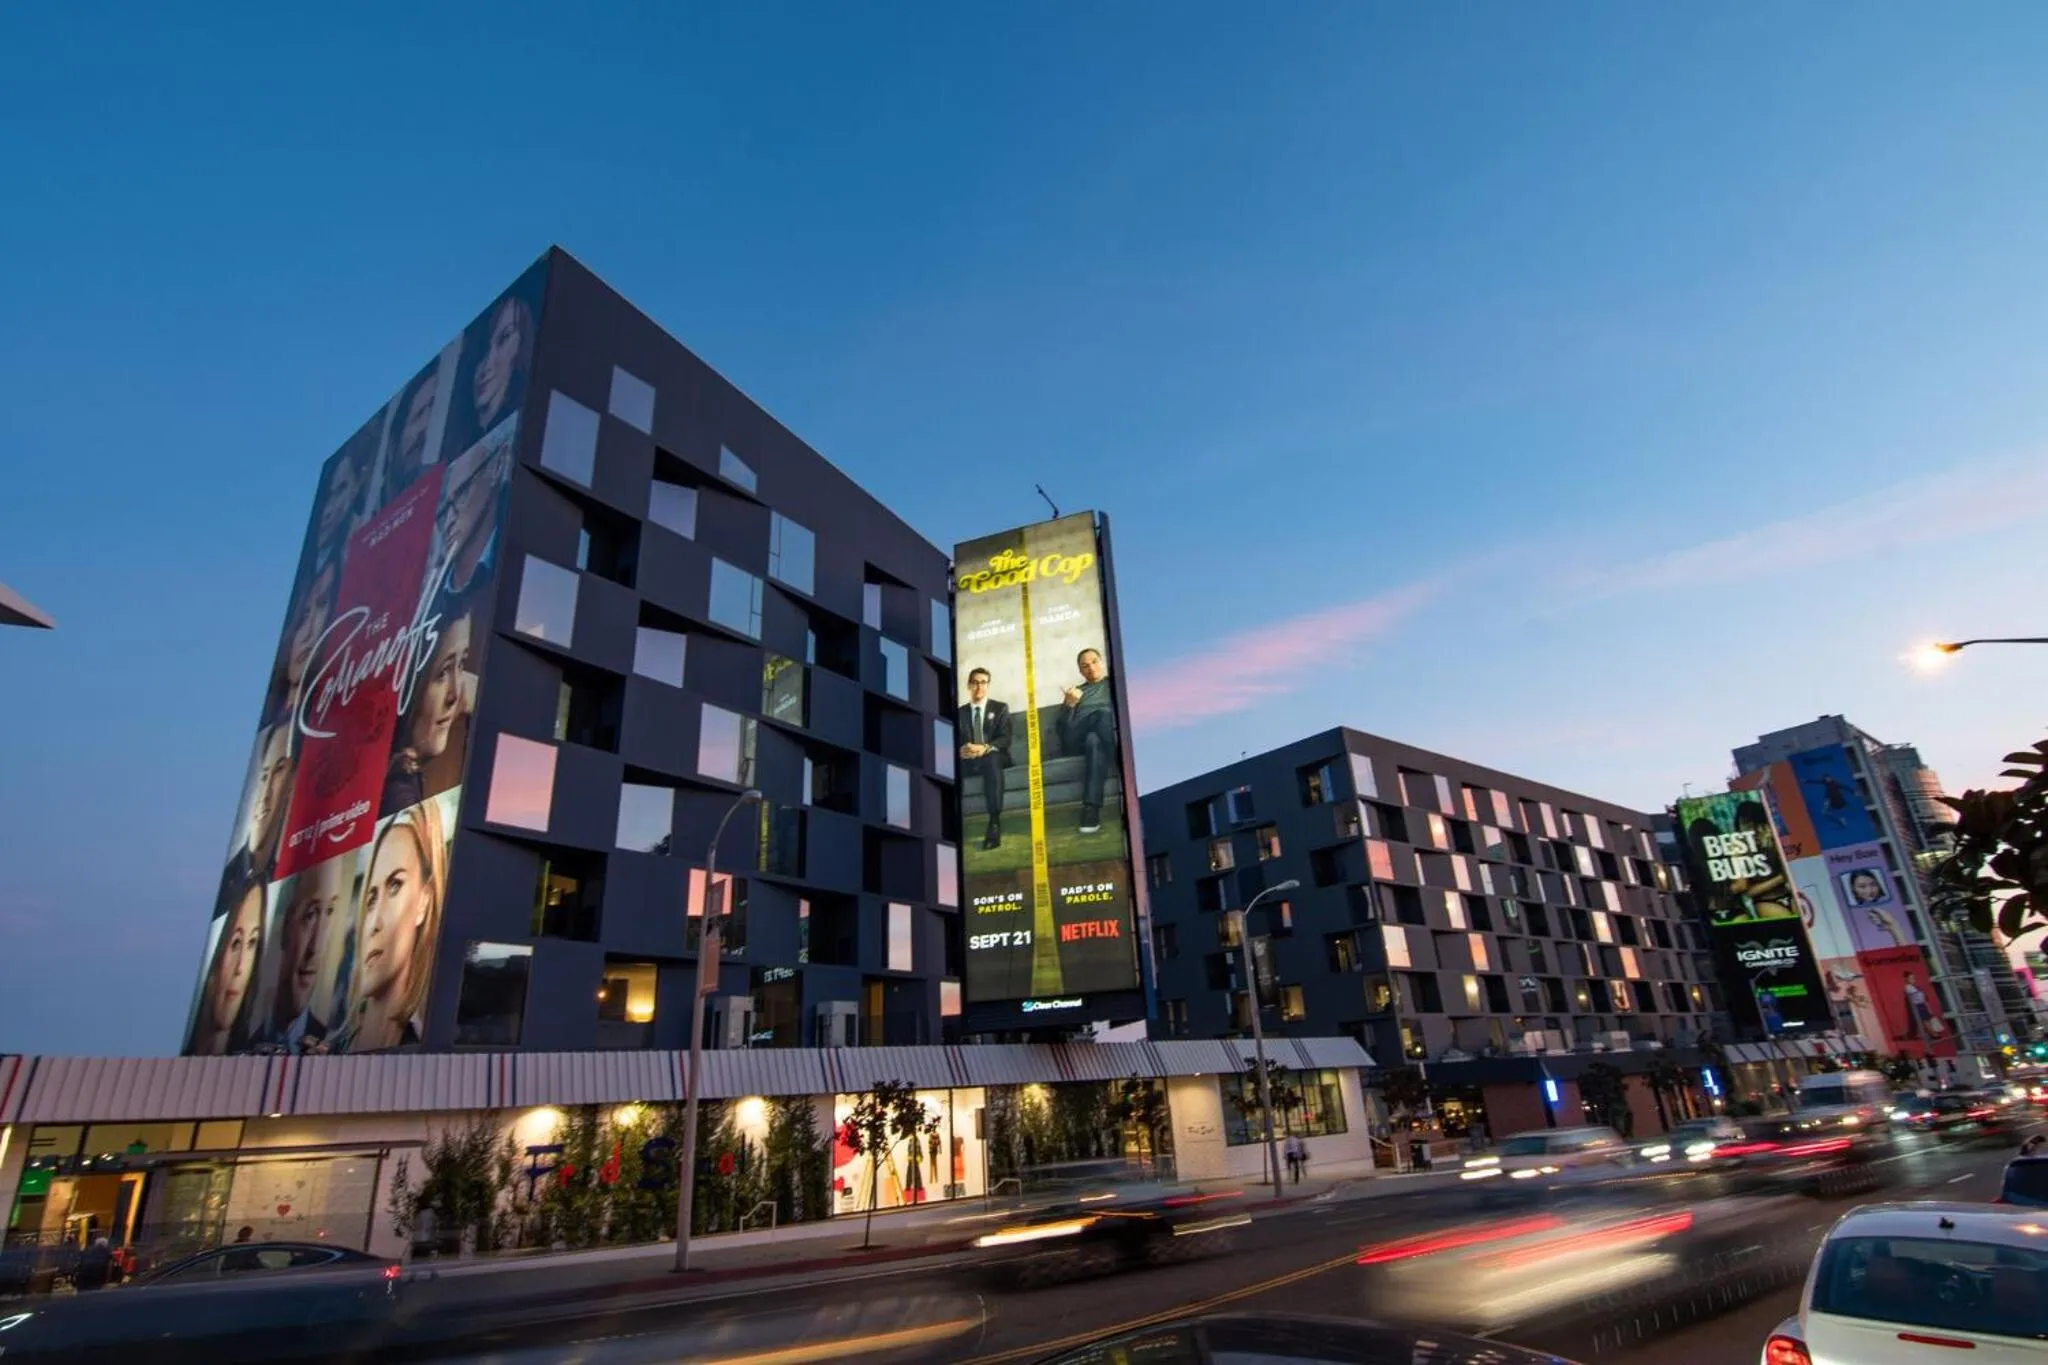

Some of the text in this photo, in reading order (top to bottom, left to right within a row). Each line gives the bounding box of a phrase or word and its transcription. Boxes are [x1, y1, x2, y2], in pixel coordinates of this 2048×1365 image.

[989, 549, 1029, 574] The
[958, 553, 1094, 593] Good Cop
[364, 611, 390, 640] THE
[346, 799, 371, 821] video
[1703, 831, 1758, 857] BEST
[1707, 854, 1772, 882] BUDS
[973, 892, 1023, 906] SON'S ON
[1060, 882, 1114, 896] DAD'S ON
[1066, 892, 1113, 904] PAROLE.
[978, 902, 1022, 914] PATROL.
[969, 930, 1032, 950] SEPT 21
[1061, 919, 1120, 942] NETFLIX
[1736, 945, 1800, 962] IGNITE
[1032, 997, 1083, 1011] Clear Channel
